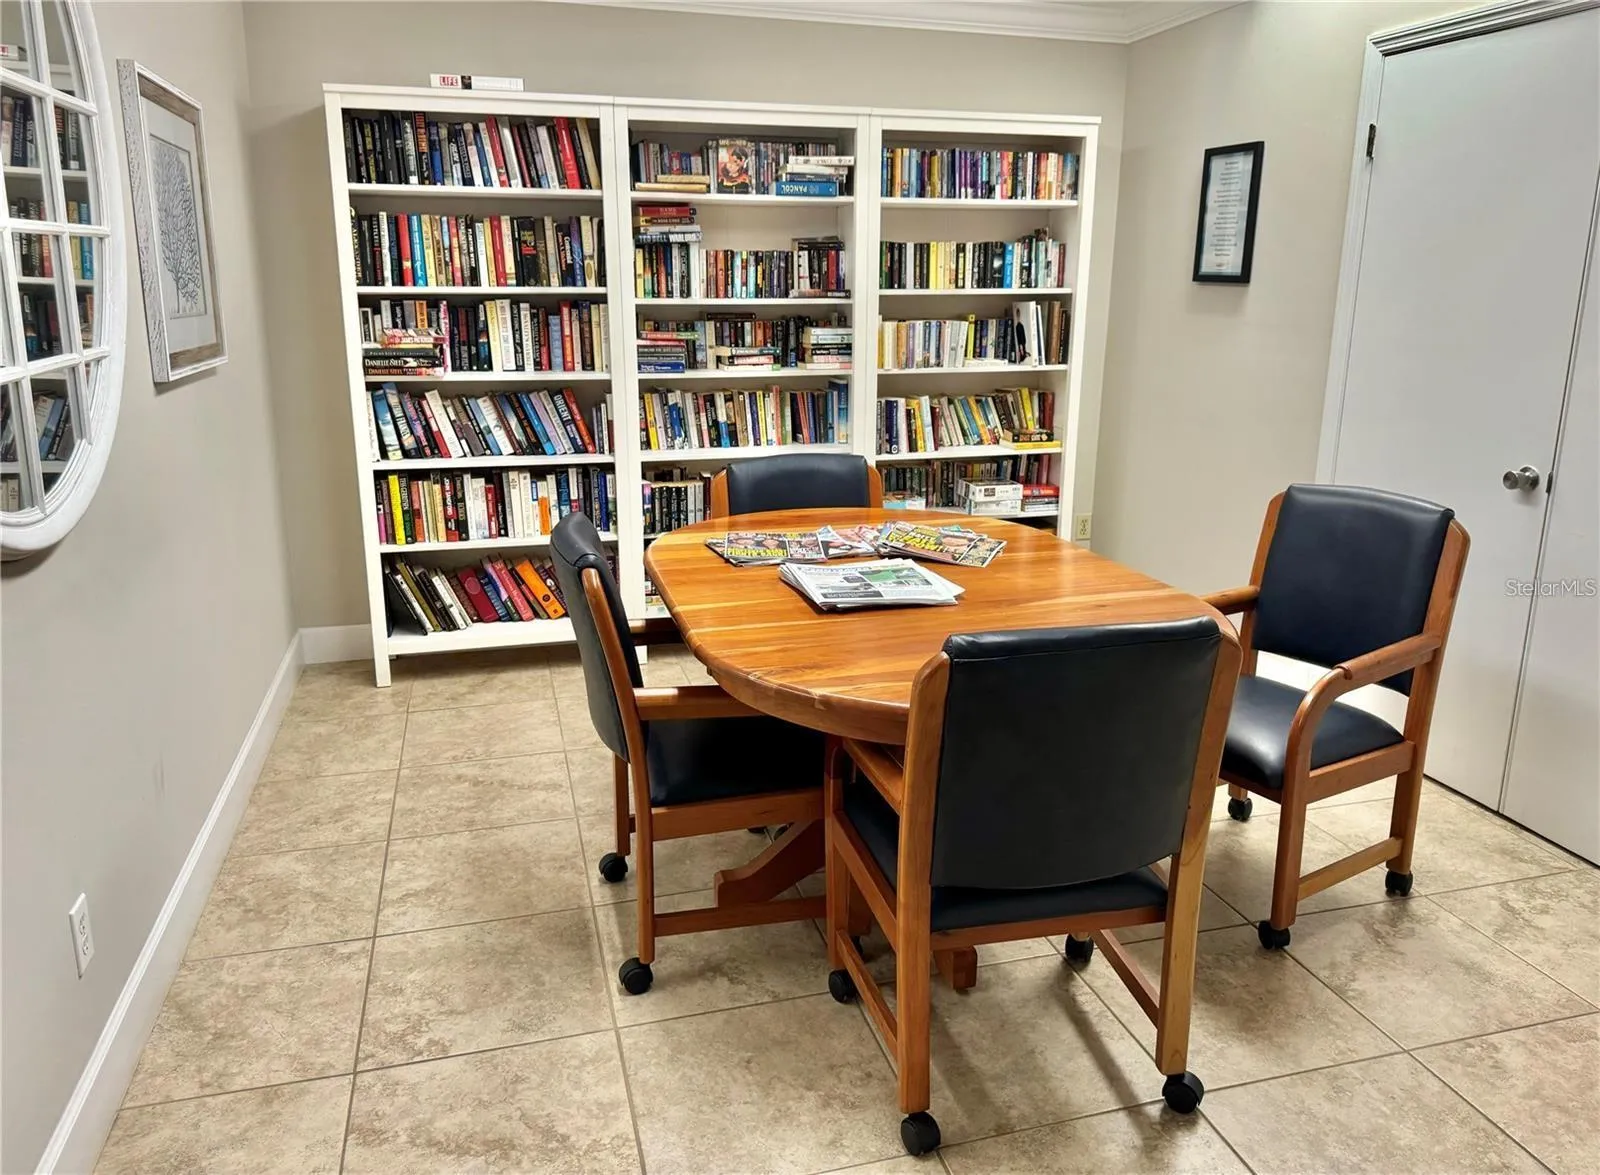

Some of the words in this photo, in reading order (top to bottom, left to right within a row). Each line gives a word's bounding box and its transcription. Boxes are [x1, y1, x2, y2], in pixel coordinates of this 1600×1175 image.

[440, 76, 459, 86] LIFE
[781, 184, 807, 193] PANCOL
[554, 394, 572, 422] ORIENT
